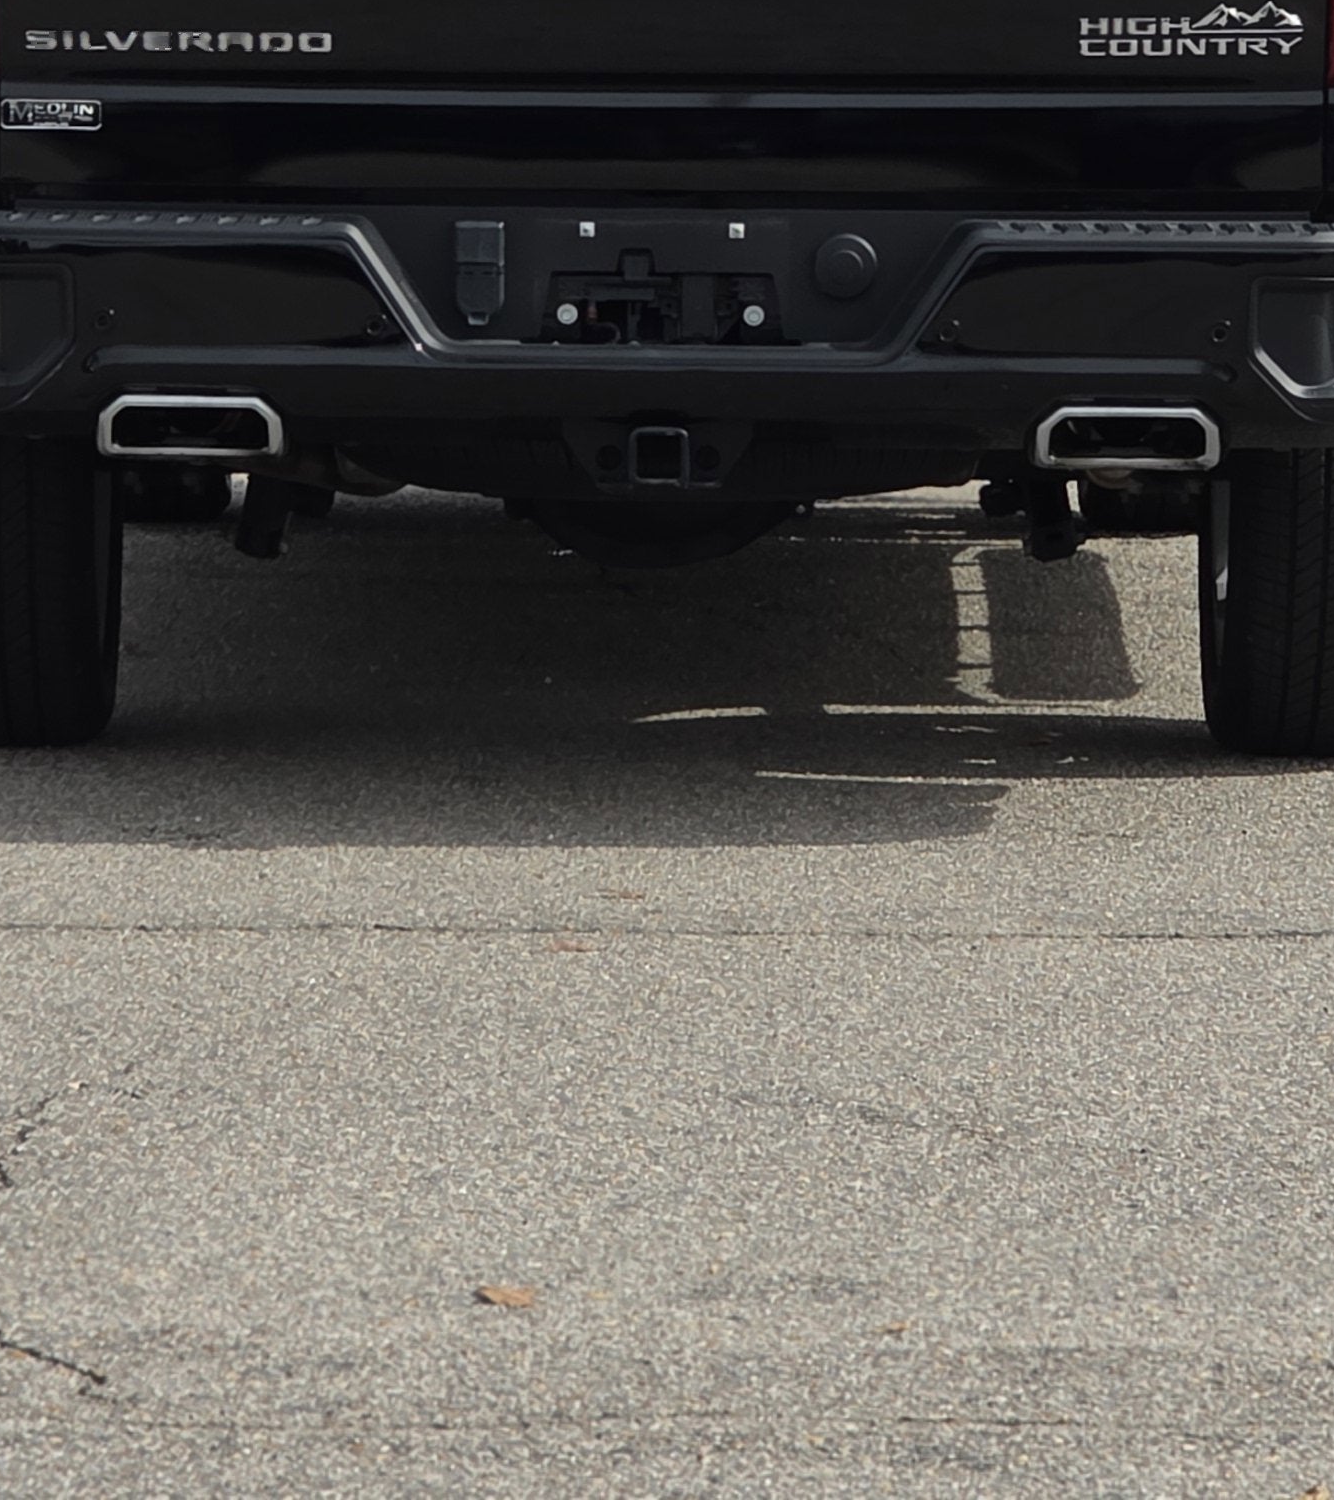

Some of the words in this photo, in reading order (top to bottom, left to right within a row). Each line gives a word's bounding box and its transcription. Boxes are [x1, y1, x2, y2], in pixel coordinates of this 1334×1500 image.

[1079, 16, 1191, 36] HIGH
[25, 29, 333, 53] SILVERADO
[1079, 37, 1303, 57] COUNTRY
